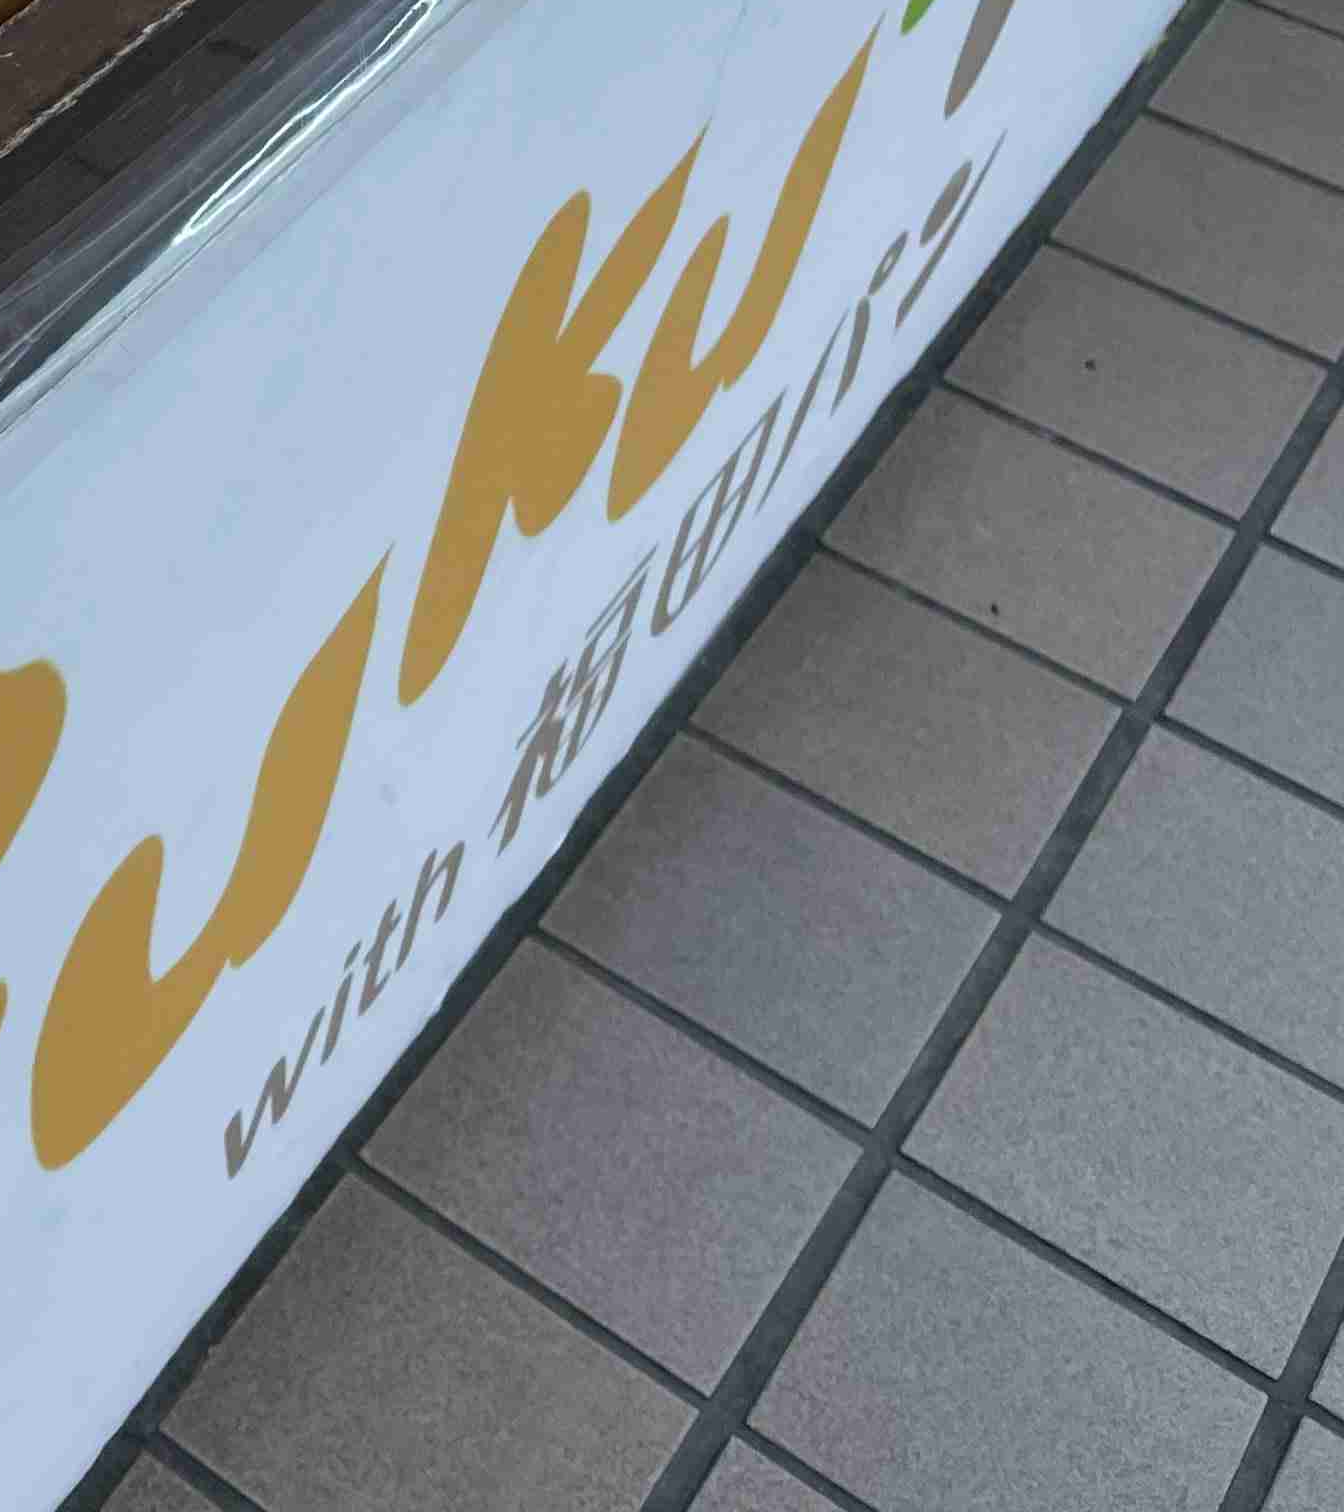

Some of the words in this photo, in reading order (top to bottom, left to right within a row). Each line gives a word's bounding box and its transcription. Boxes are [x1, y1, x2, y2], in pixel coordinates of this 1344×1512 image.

[224, 840, 466, 1180] with
[487, 128, 1008, 858] 福田パン
